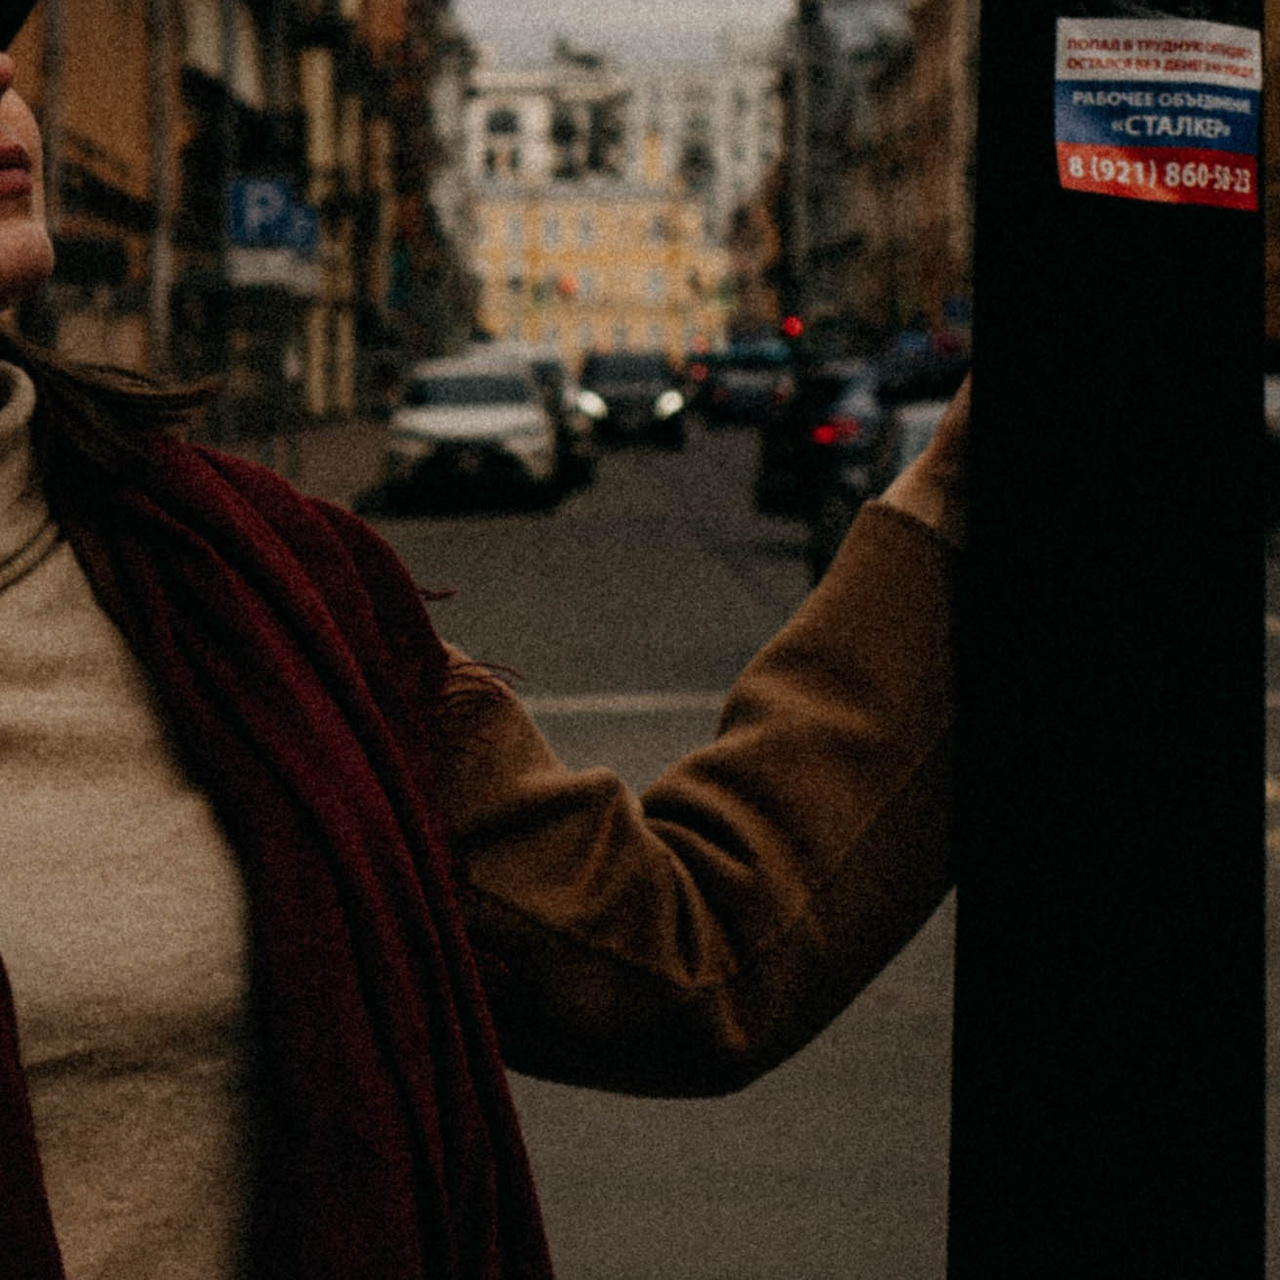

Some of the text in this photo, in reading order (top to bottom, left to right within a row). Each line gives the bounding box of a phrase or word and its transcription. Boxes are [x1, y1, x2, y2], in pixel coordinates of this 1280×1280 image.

[1072, 91, 1154, 107] РАБОЧЕЕ
[1068, 155, 1084, 178] 8
[1091, 155, 1157, 188] (921)
